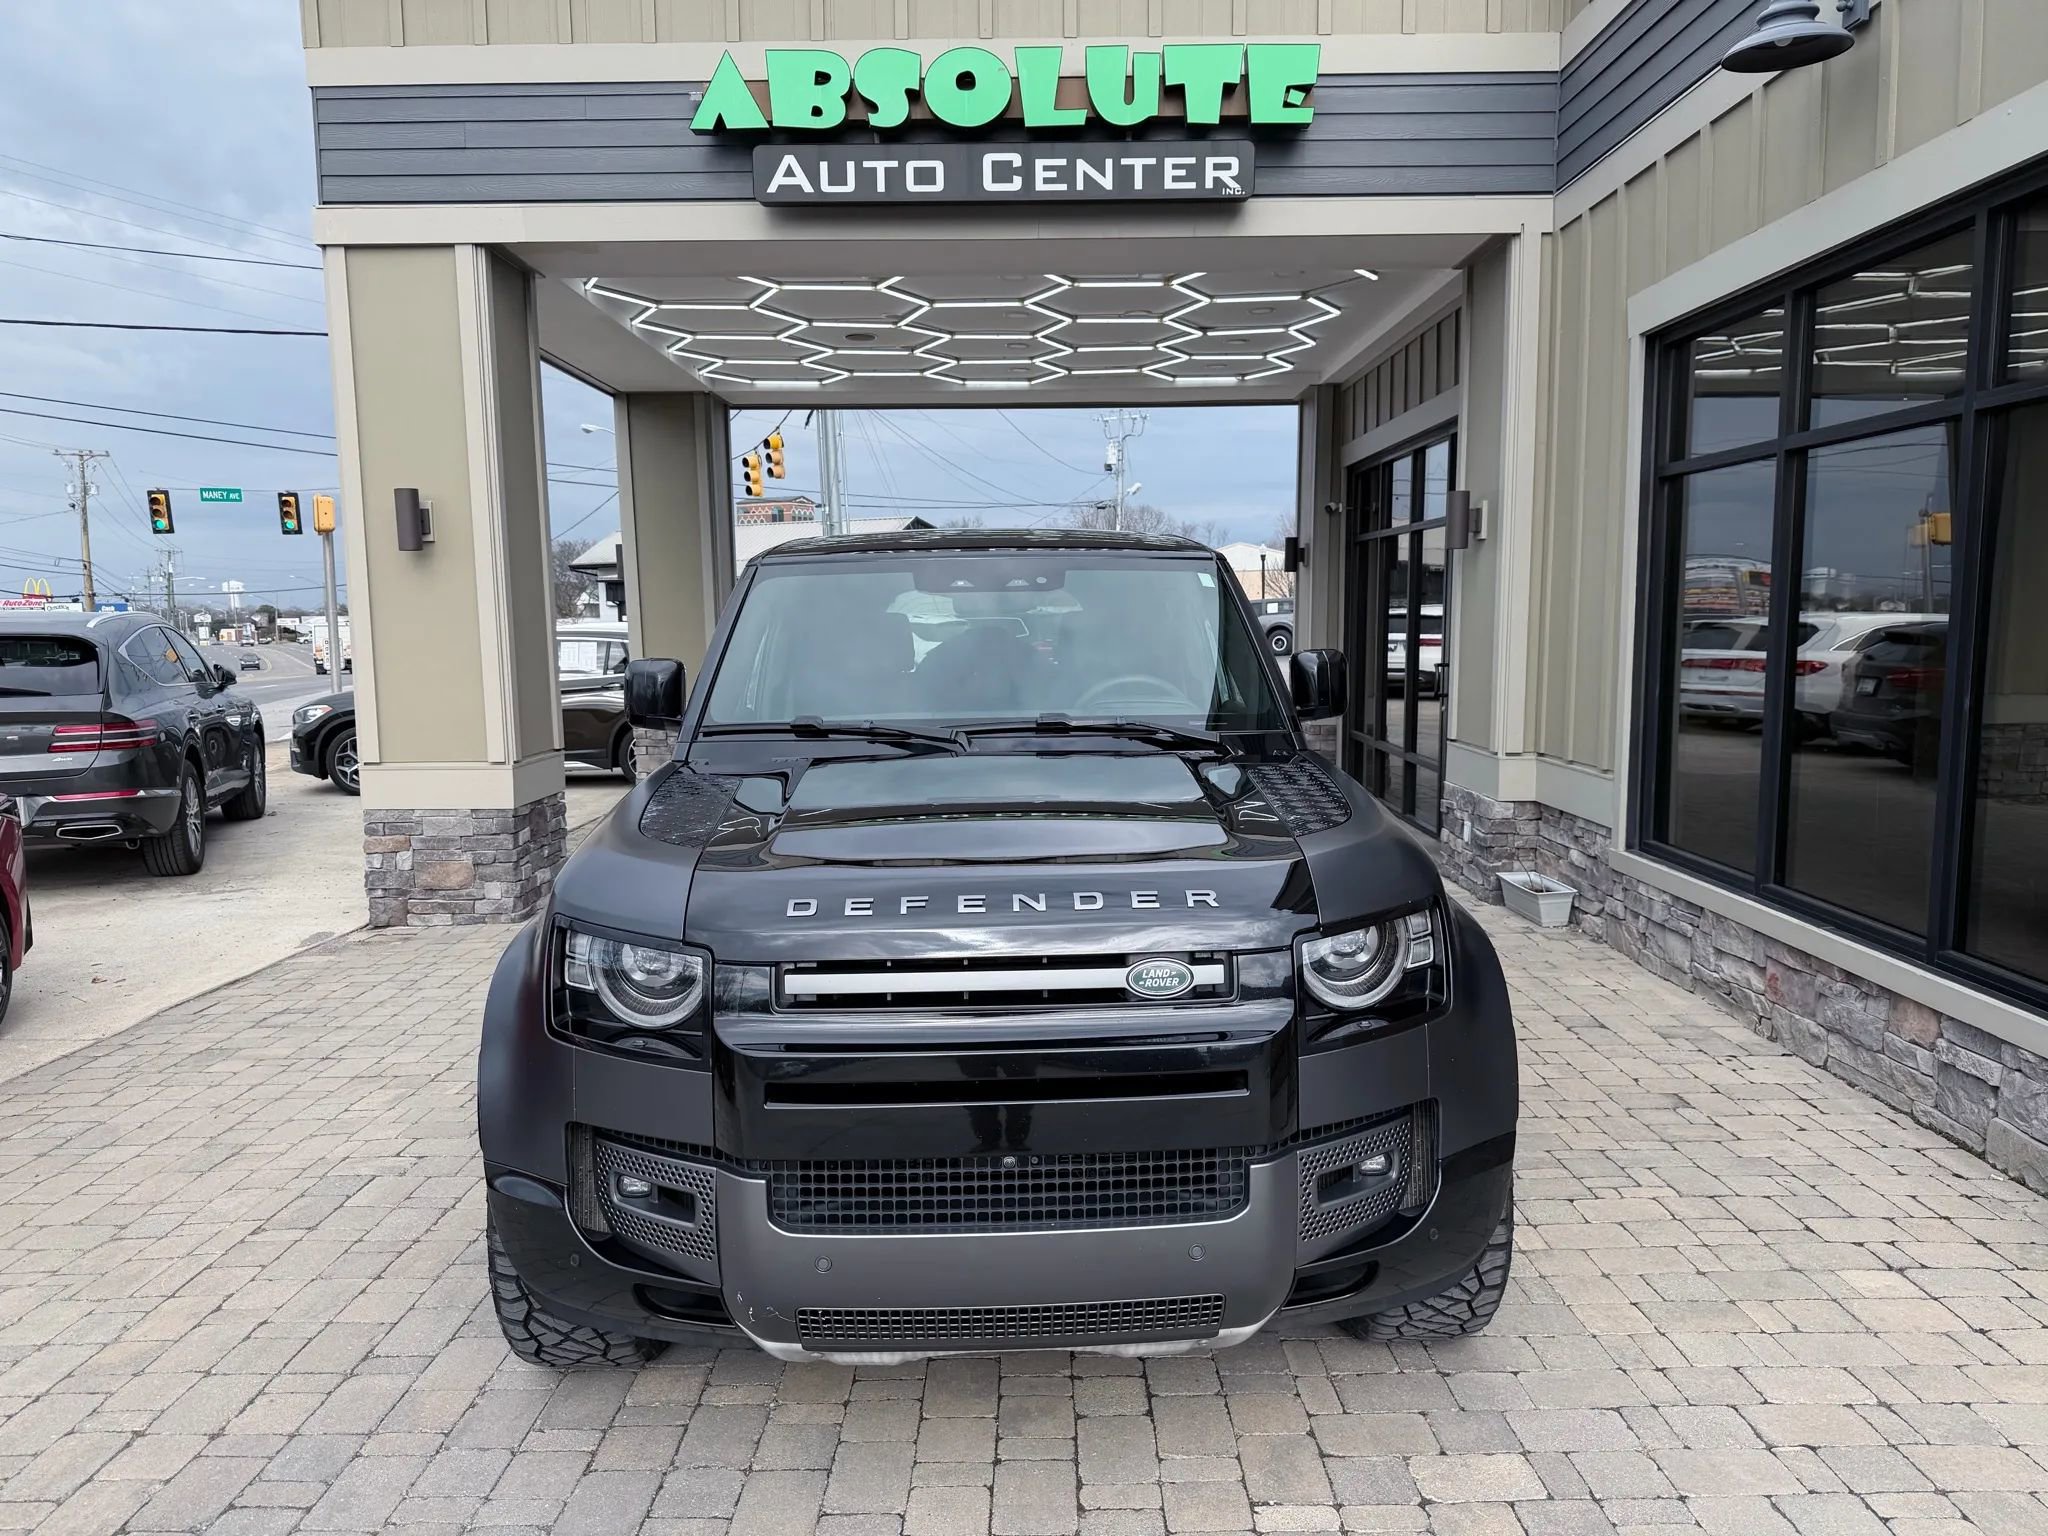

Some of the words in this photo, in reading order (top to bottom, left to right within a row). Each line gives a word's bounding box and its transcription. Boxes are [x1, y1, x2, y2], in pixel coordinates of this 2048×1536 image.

[690, 43, 1321, 132] ABSOLUTE
[766, 154, 944, 193] AUTO
[982, 152, 1241, 192] CENTER
[1222, 187, 1246, 195] INC.
[202, 490, 228, 499] MANEY
[230, 492, 241, 500] AVE
[2, 599, 43, 607] AutoZone
[786, 889, 1221, 918] DEFENDER
[1142, 969, 1171, 978] LAND
[1145, 977, 1180, 987] ROVER
